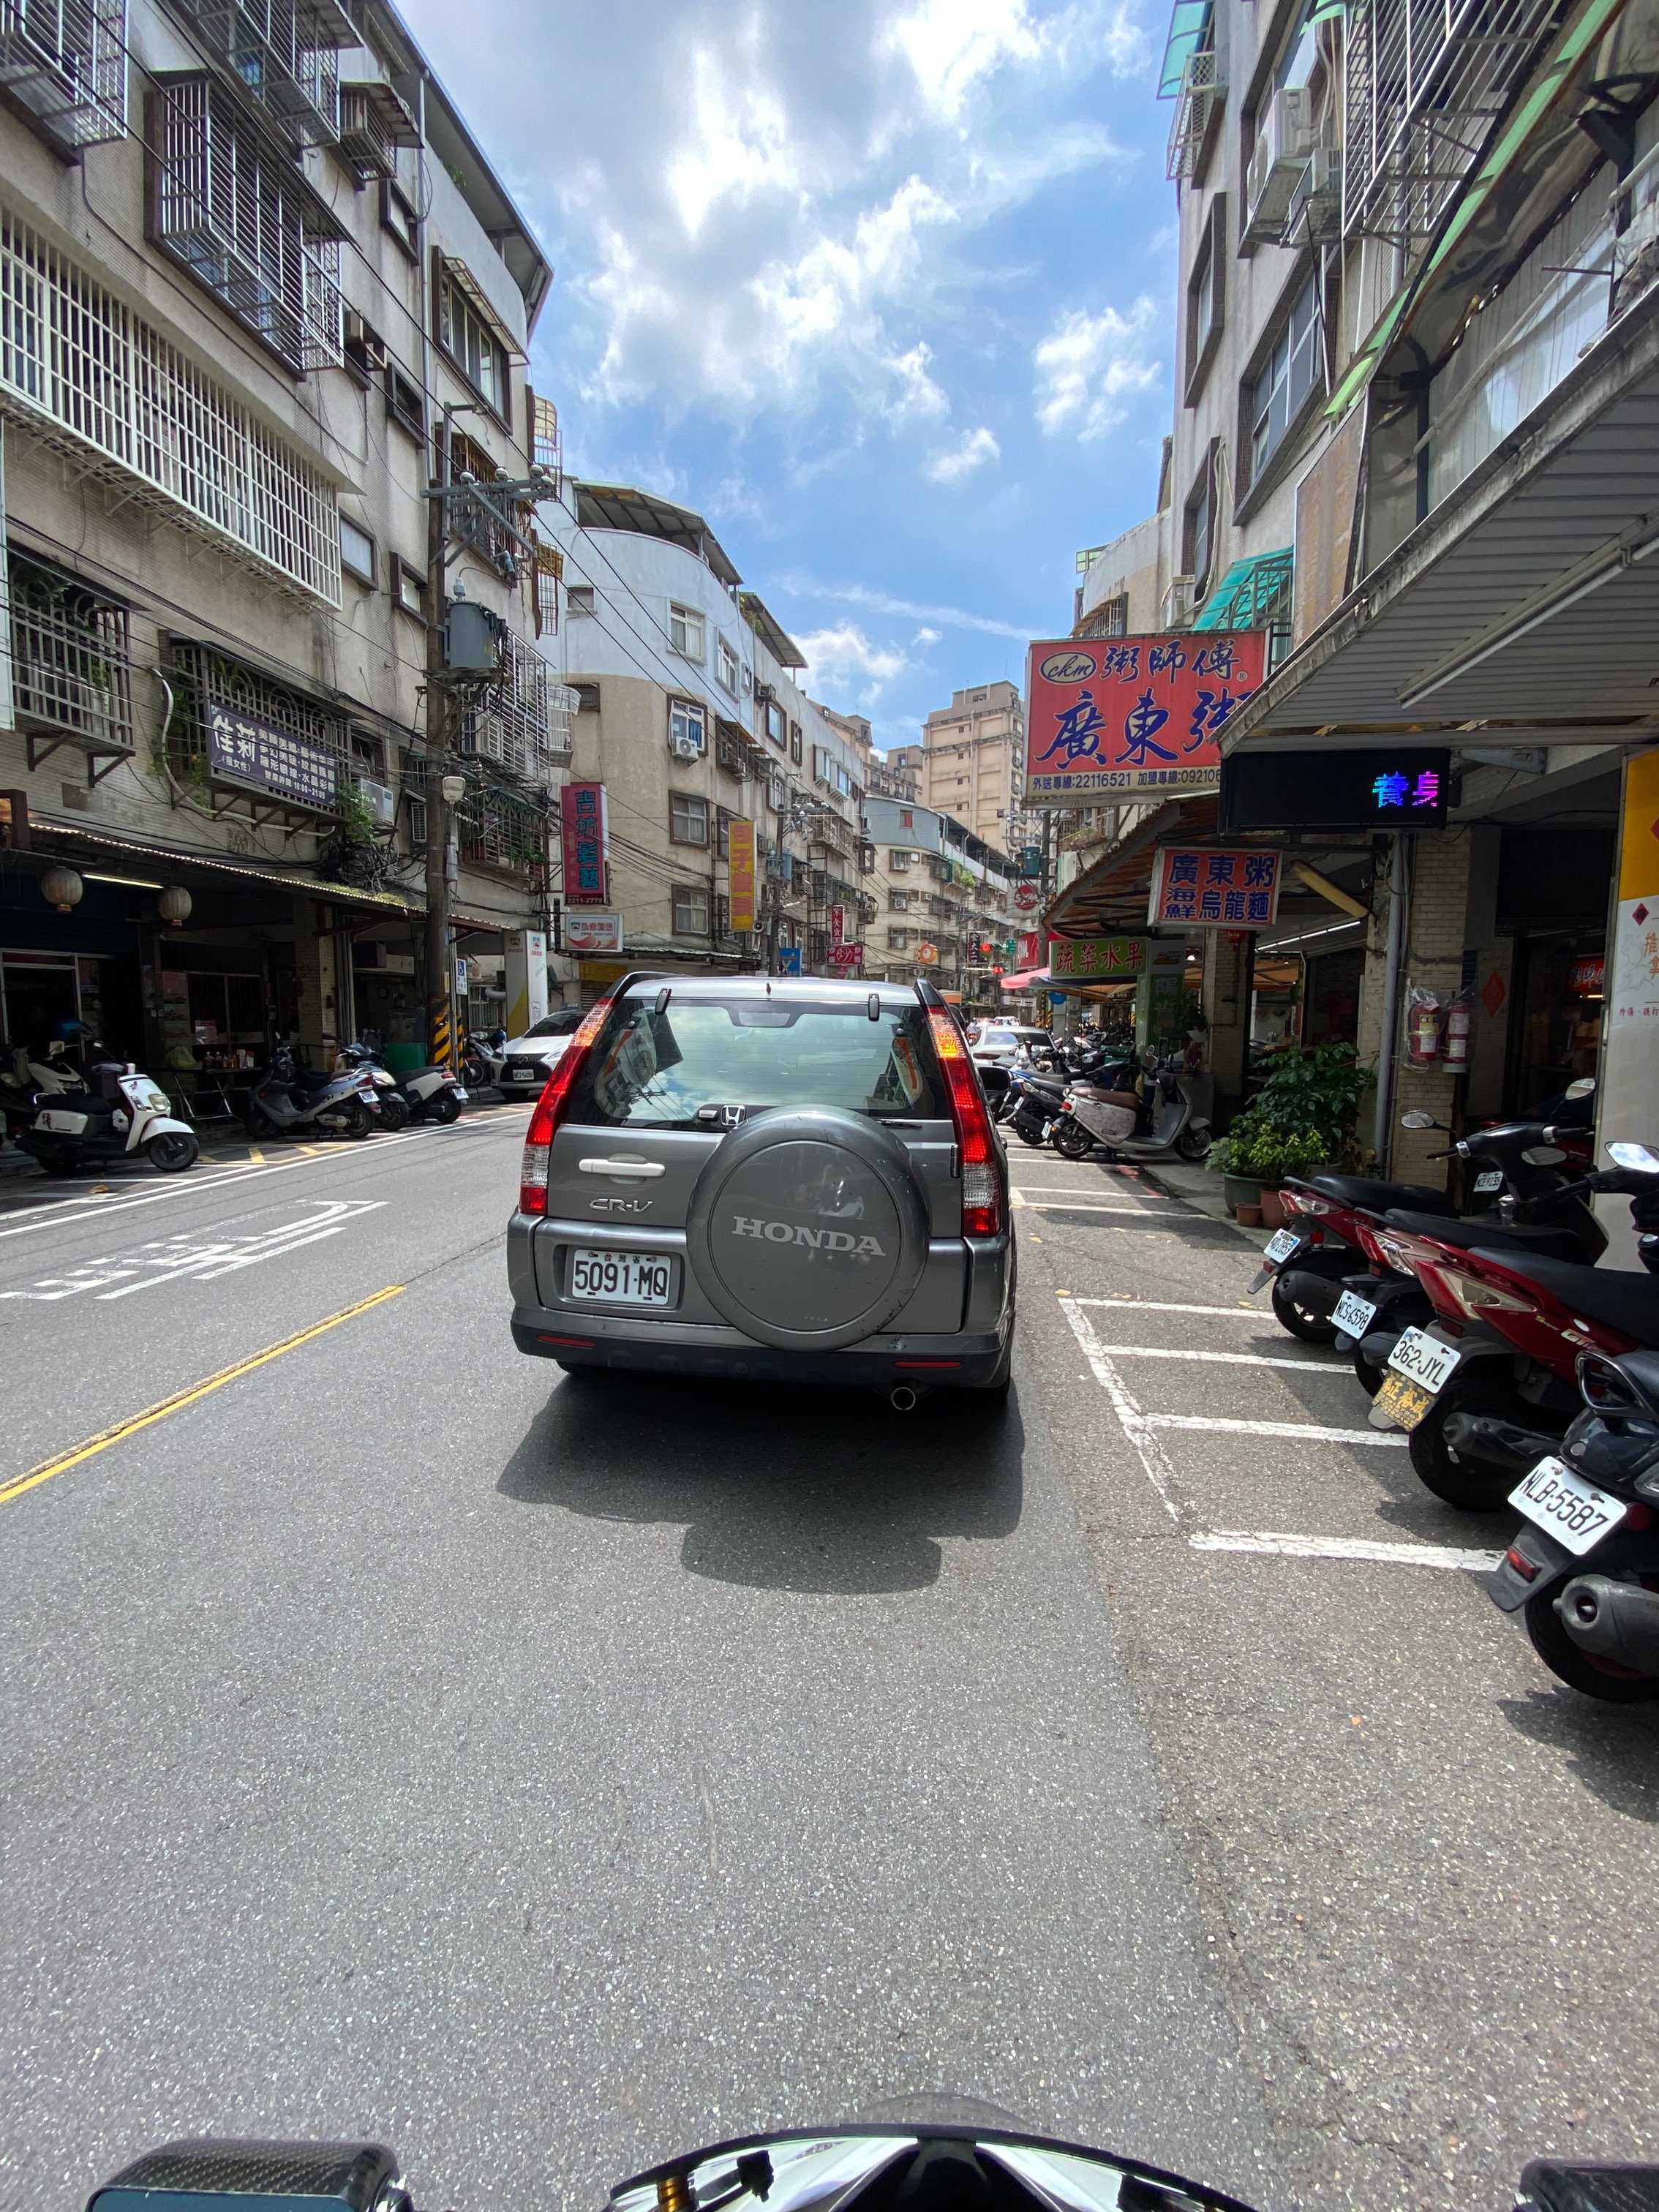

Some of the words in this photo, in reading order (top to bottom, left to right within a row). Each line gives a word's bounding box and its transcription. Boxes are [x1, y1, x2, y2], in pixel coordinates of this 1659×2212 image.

[1099, 639, 1240, 684] 粥師傅
[1169, 853, 1276, 887] 廣東粥
[1056, 941, 1144, 974] 蔬菜水果
[589, 1197, 653, 1213] CR-V
[732, 1215, 886, 1257] HONDA
[574, 1260, 669, 1298] 5091-MQ
[1335, 1299, 1369, 1331] NCS-6598
[1393, 1340, 1445, 1386] 362-JYL
[1519, 1469, 1611, 1537] NLB-5587
